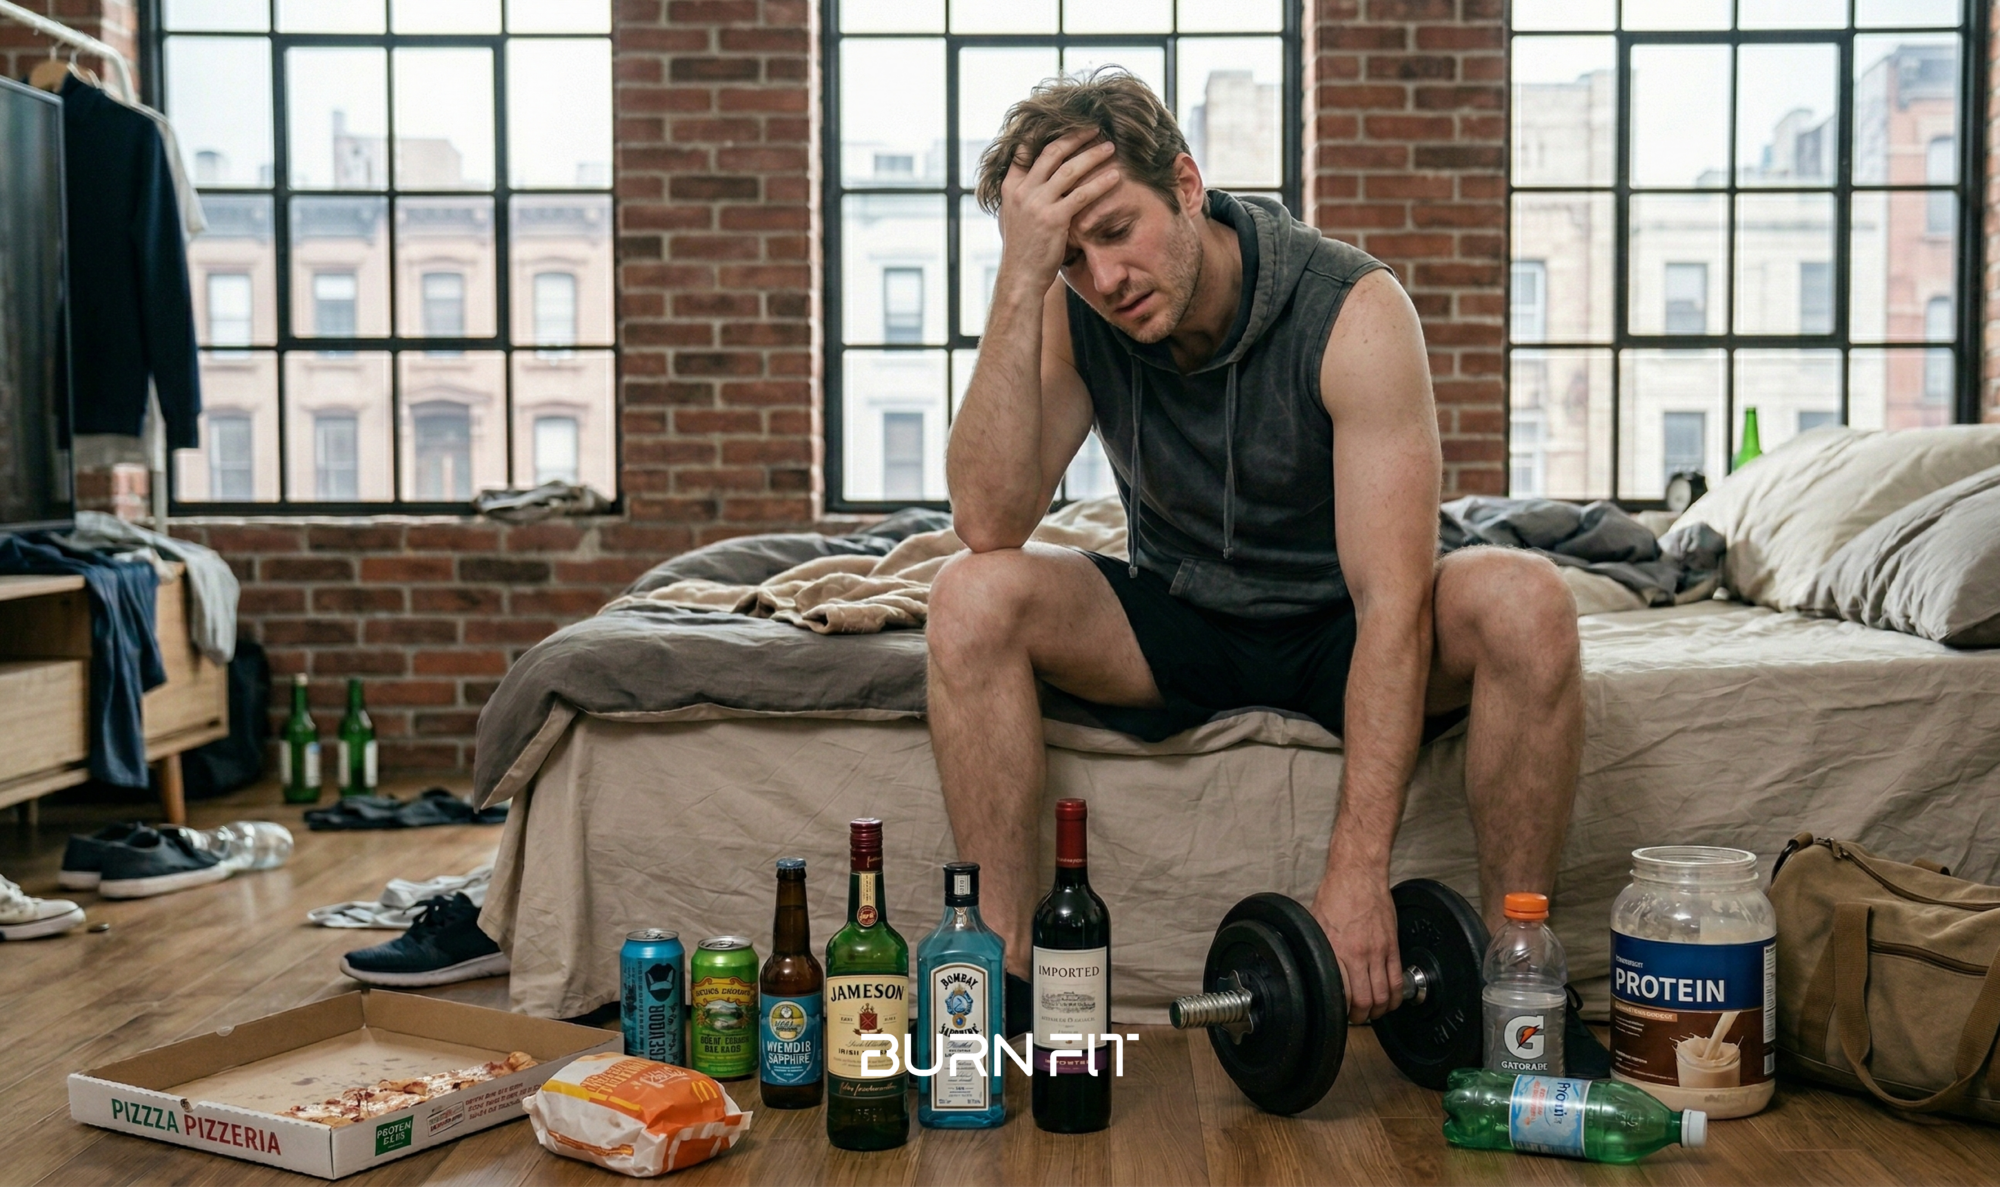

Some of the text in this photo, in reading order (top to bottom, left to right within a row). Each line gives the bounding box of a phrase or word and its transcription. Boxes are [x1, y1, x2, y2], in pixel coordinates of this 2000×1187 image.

[940, 972, 979, 990] BOMBAY
[1038, 965, 1100, 978] IMPORTED
[830, 983, 904, 1002] JAMESON
[1616, 967, 1725, 1003] PROTEIN
[1504, 1015, 1545, 1060] G
[768, 1053, 811, 1065] SAPPHIRE
[111, 1098, 281, 1156] PIZZZA PIZZERIA
